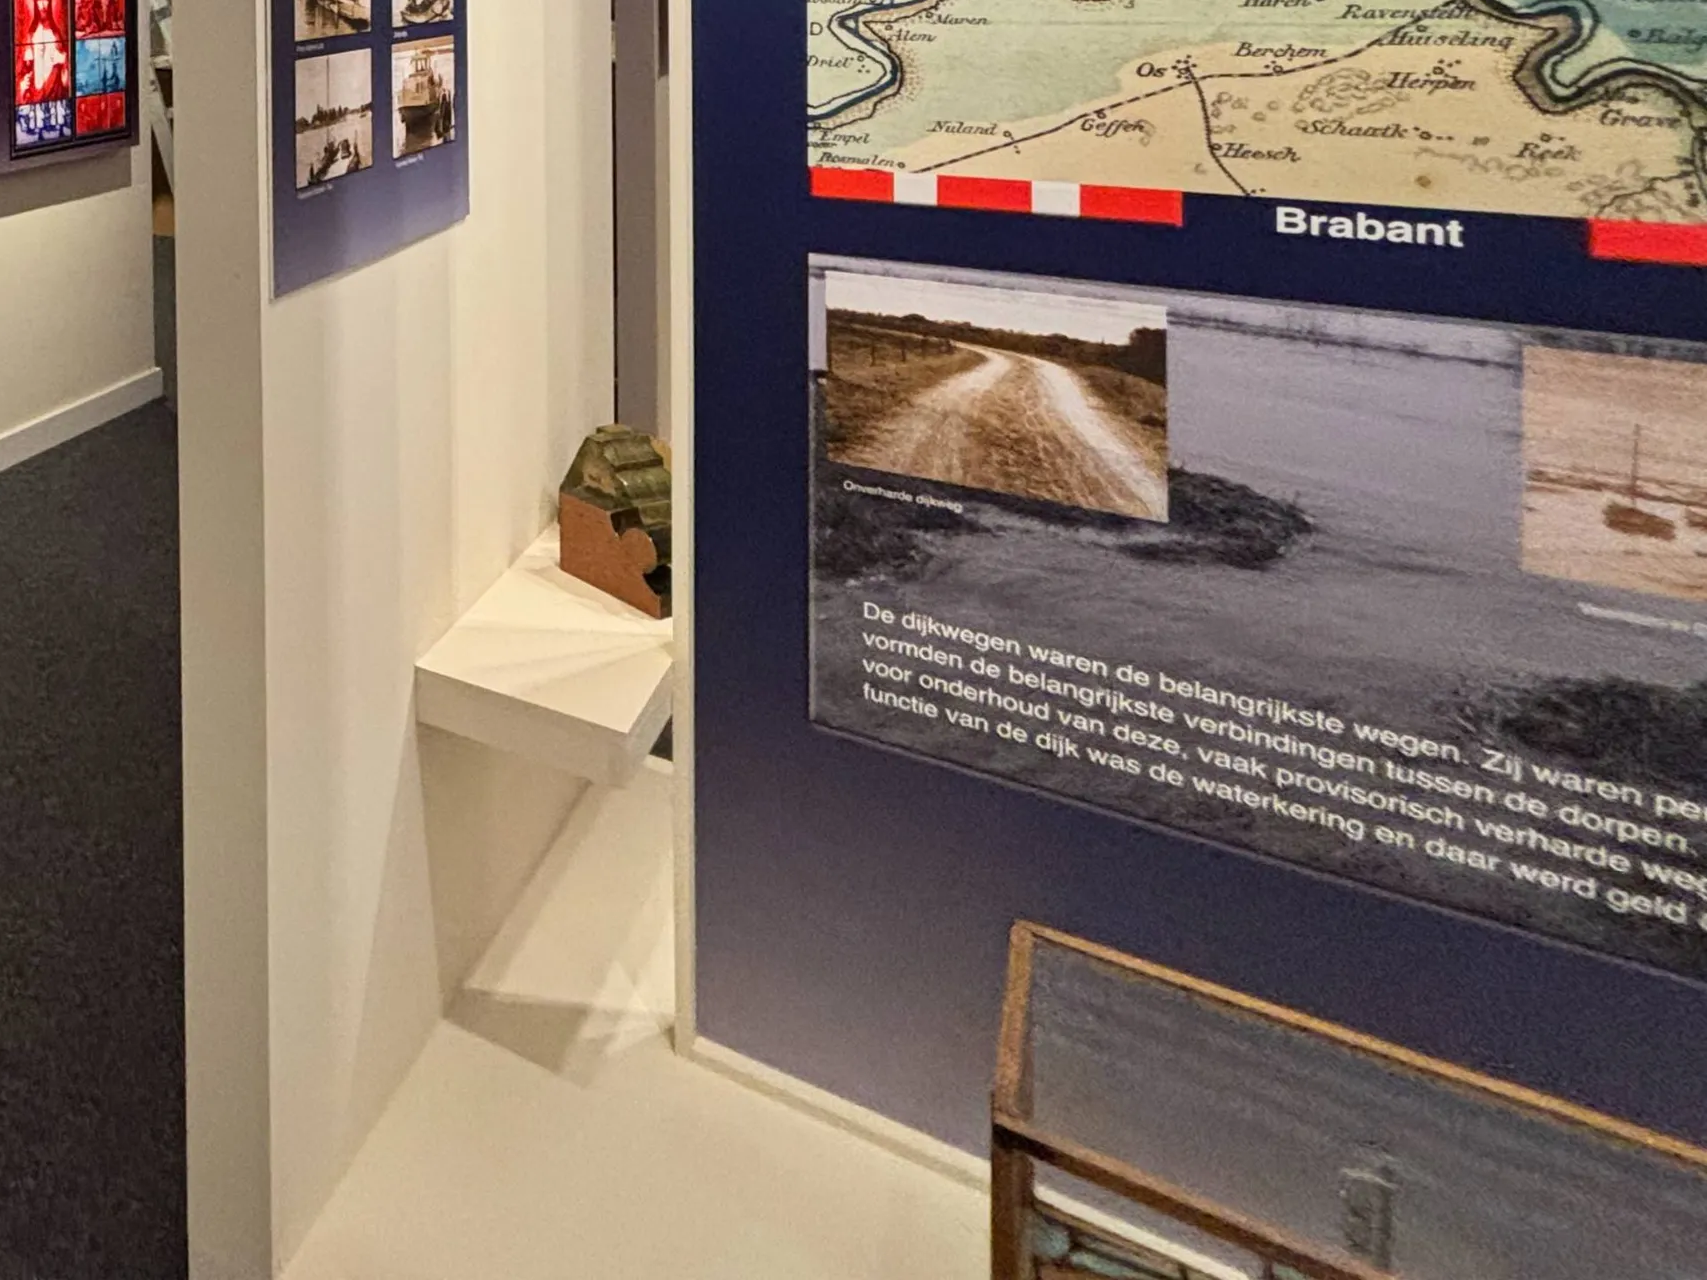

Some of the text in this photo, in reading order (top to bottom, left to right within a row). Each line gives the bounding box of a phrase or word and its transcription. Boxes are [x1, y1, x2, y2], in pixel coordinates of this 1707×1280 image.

[1276, 208, 1465, 249] Brabant
[843, 480, 964, 515] Onverharde dijkweg
[861, 658, 913, 684] voor
[918, 673, 1050, 722] onderhoud
[1056, 708, 1105, 737] van
[1112, 723, 1188, 761] deze,
[1196, 745, 1267, 780] vaak
[1275, 766, 1465, 831] provisorisch
[1474, 818, 1632, 874] verharde
[862, 631, 1698, 856] vormden de belangrijkste verbindingen tussen de dorpen.
[862, 681, 1688, 925] functie van de dijk was de waterkering en daar werd geld
[863, 600, 1707, 823] De dijkwegen waren de belangrijkste wegen. Zij waren pe
